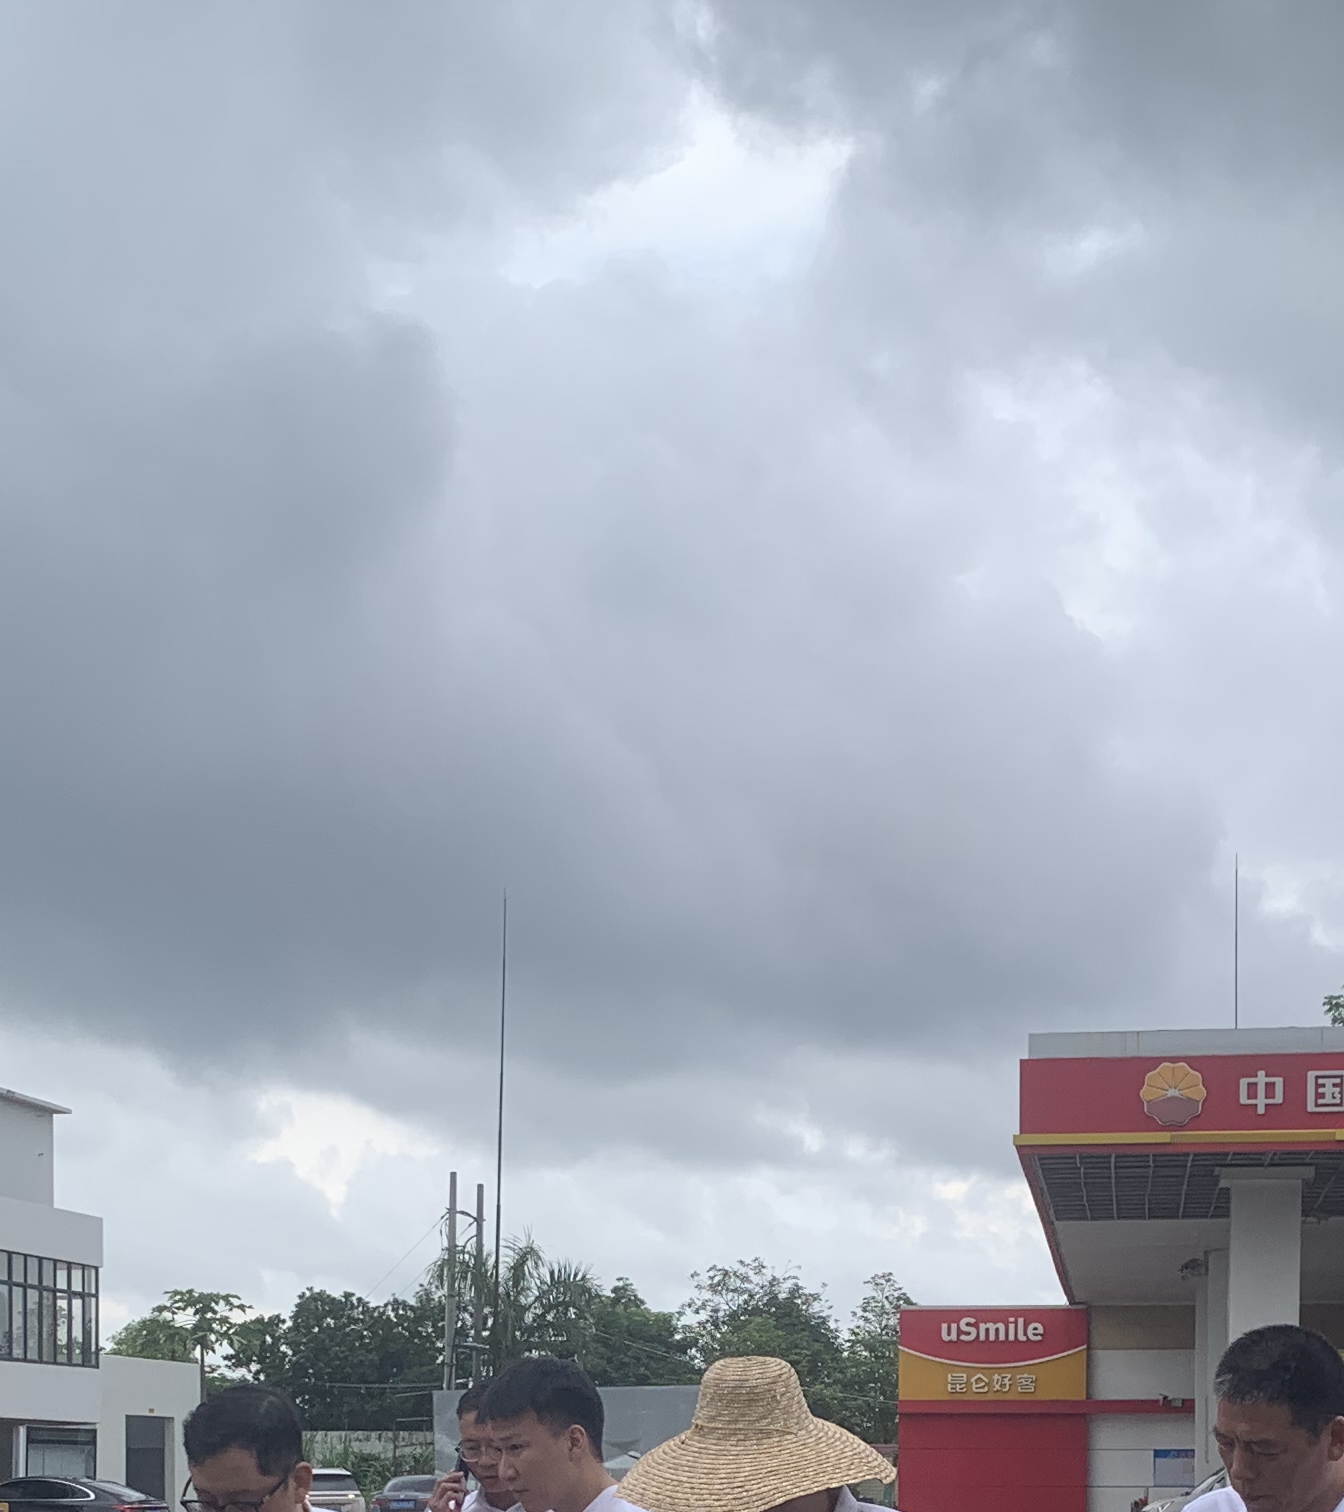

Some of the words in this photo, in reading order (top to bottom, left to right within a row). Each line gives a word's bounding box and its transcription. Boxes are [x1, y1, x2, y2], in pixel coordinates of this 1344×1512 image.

[940, 1317, 1045, 1342] uSmile
[947, 1372, 1037, 1394] 昆仑好客
